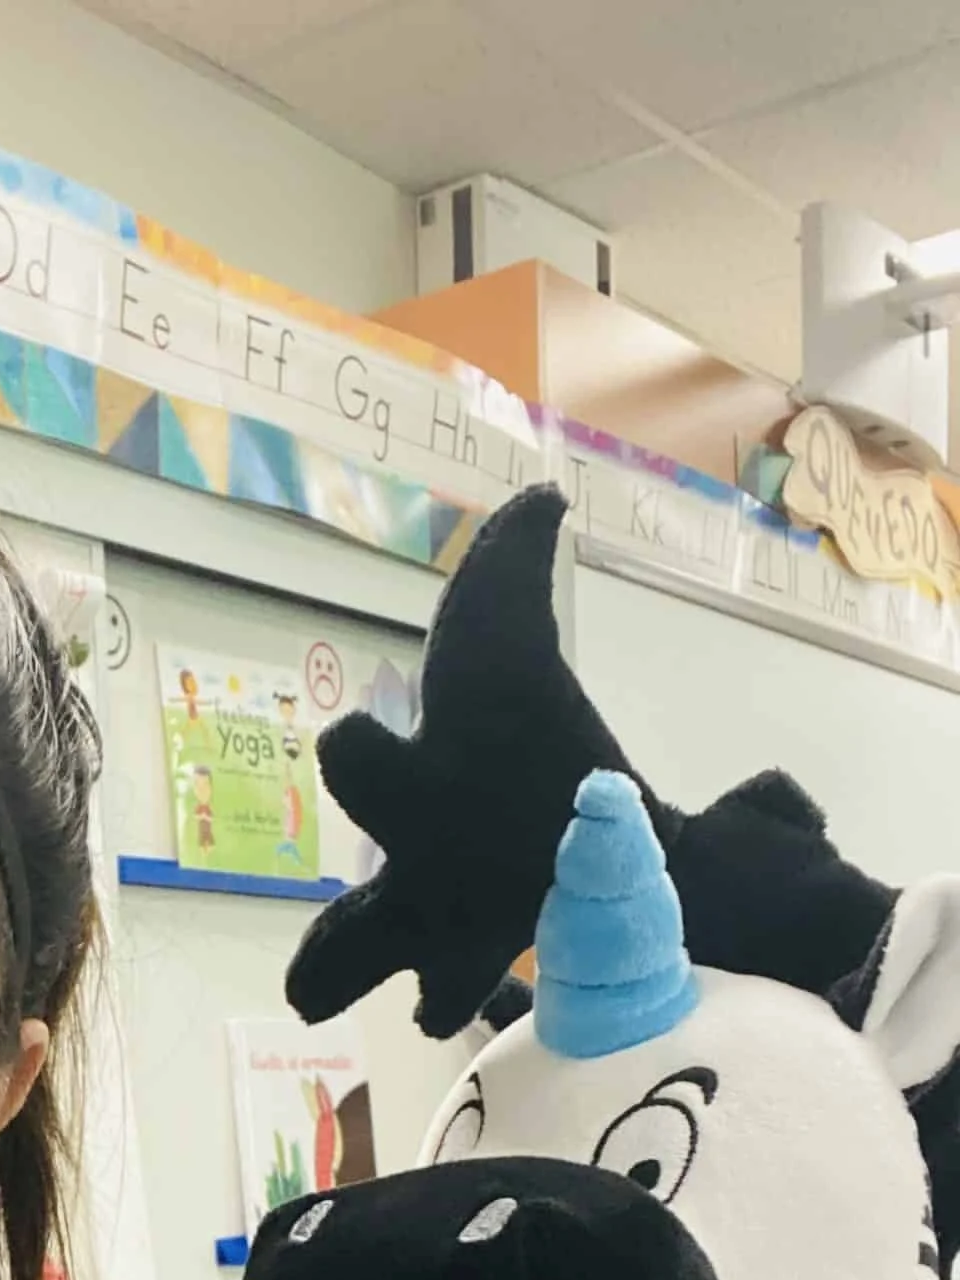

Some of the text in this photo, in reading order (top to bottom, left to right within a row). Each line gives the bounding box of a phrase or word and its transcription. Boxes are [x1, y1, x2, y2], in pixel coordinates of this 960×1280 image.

[120, 258, 171, 350] Ee
[246, 314, 294, 392] Ff
[335, 356, 392, 461] Gg
[432, 390, 478, 466] Hh
[806, 416, 939, 574] QUEVEDO
[216, 723, 275, 767] Yoga
